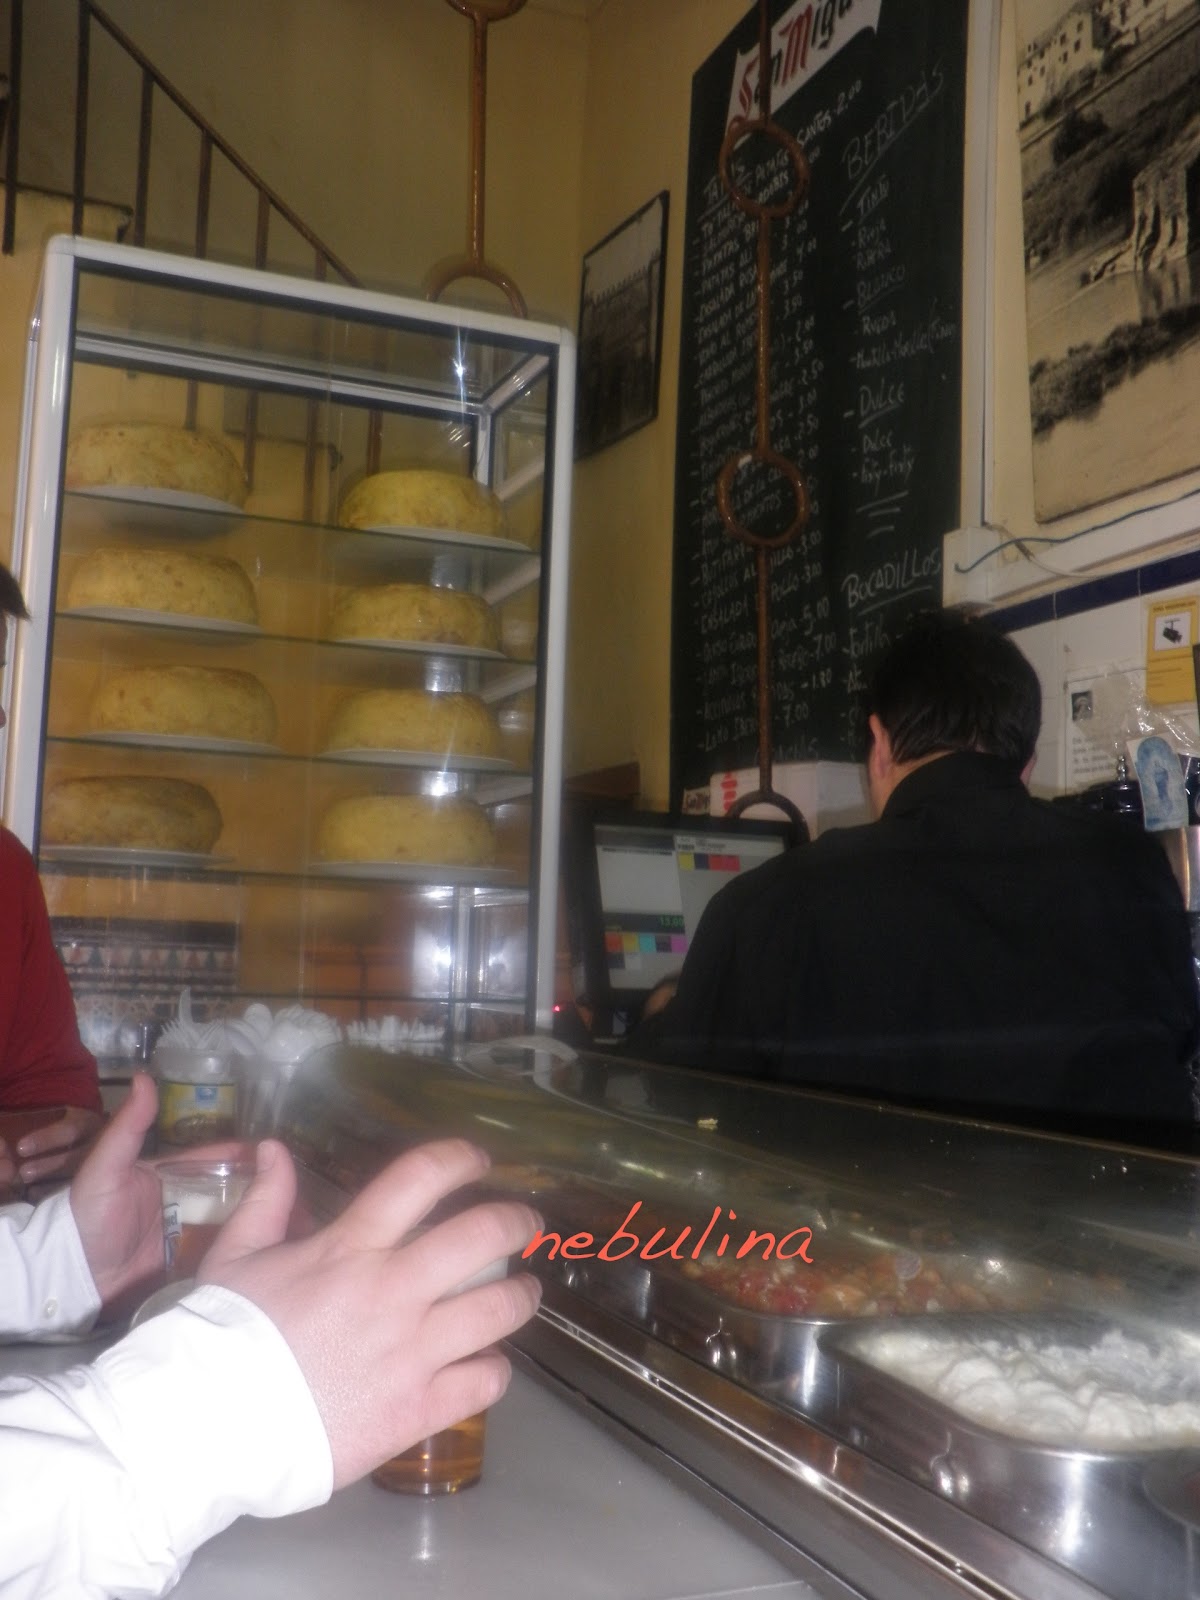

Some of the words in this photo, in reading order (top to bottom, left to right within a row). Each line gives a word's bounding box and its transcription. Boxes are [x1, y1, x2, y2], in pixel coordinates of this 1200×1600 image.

[841, 57, 944, 180] BEBIDAS
[860, 377, 905, 418] DULCE
[840, 547, 942, 609] BOCADILLOS
